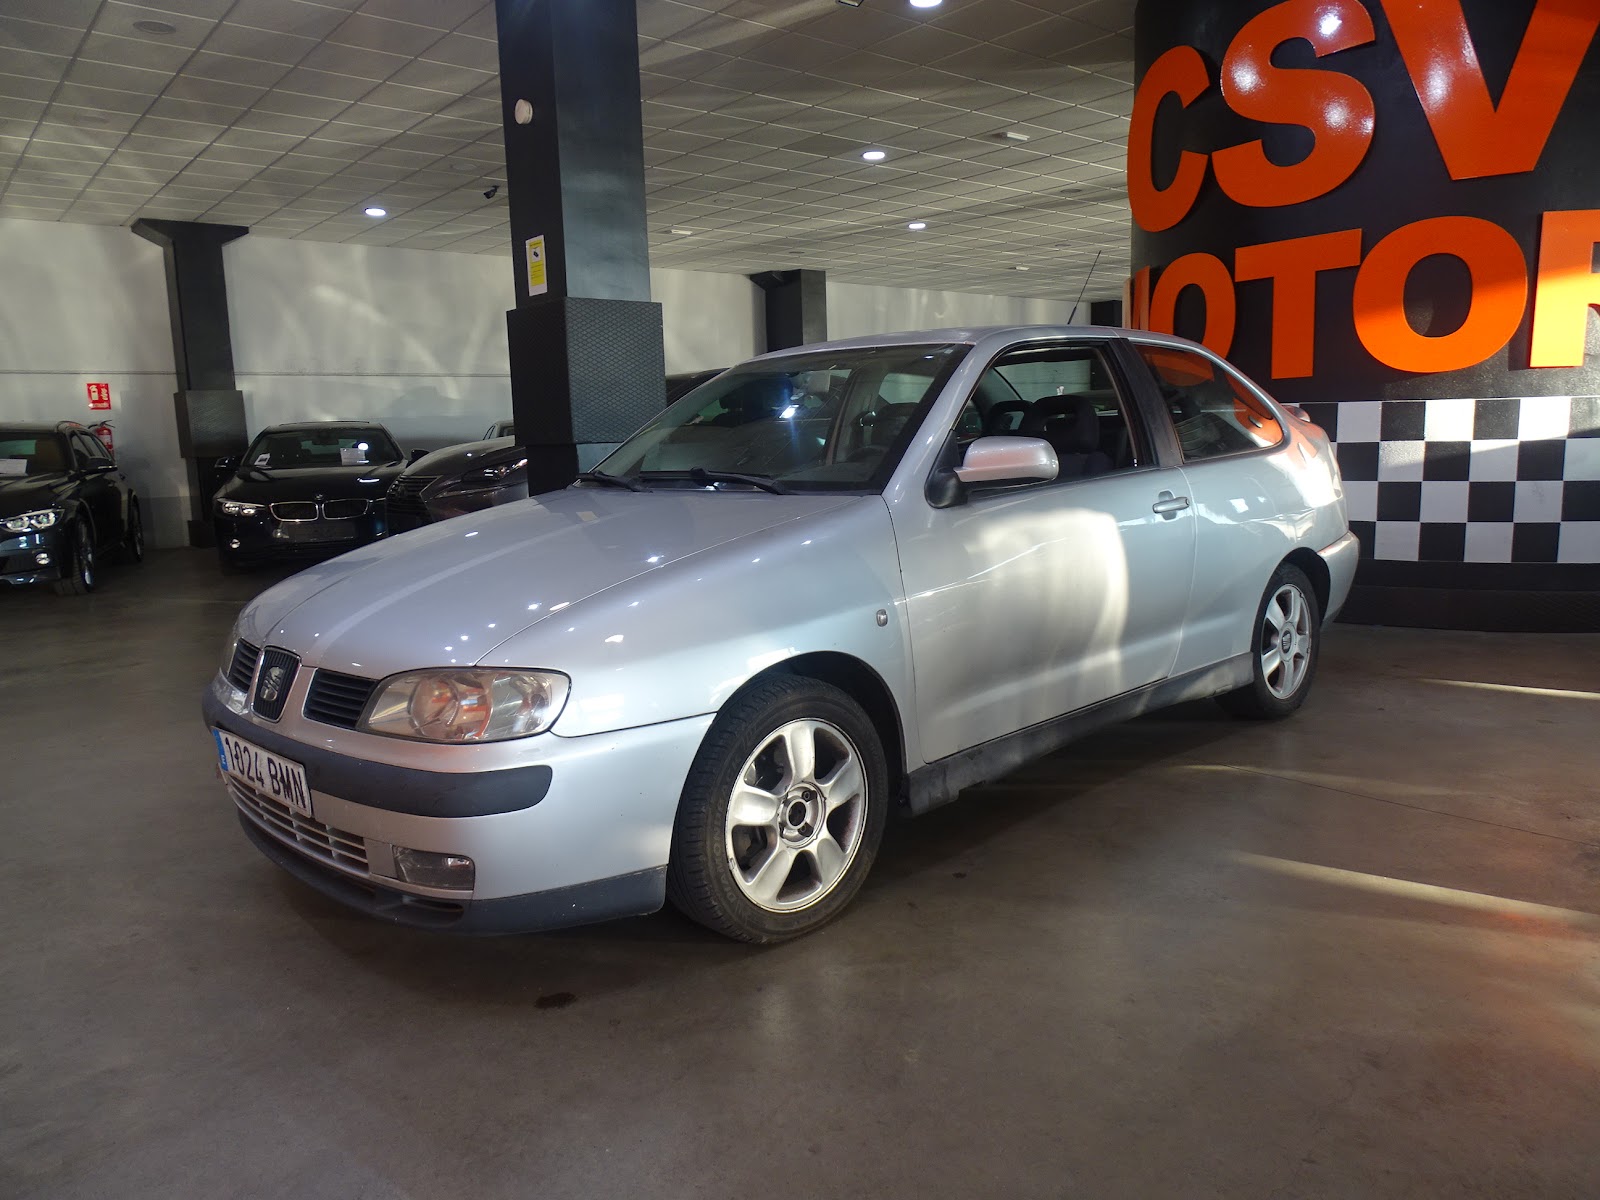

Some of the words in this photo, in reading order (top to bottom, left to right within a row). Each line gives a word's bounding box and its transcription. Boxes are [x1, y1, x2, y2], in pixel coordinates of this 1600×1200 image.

[1127, 0, 1600, 232] CSV
[225, 737, 265, 788] 1024
[267, 757, 307, 809] BMN
